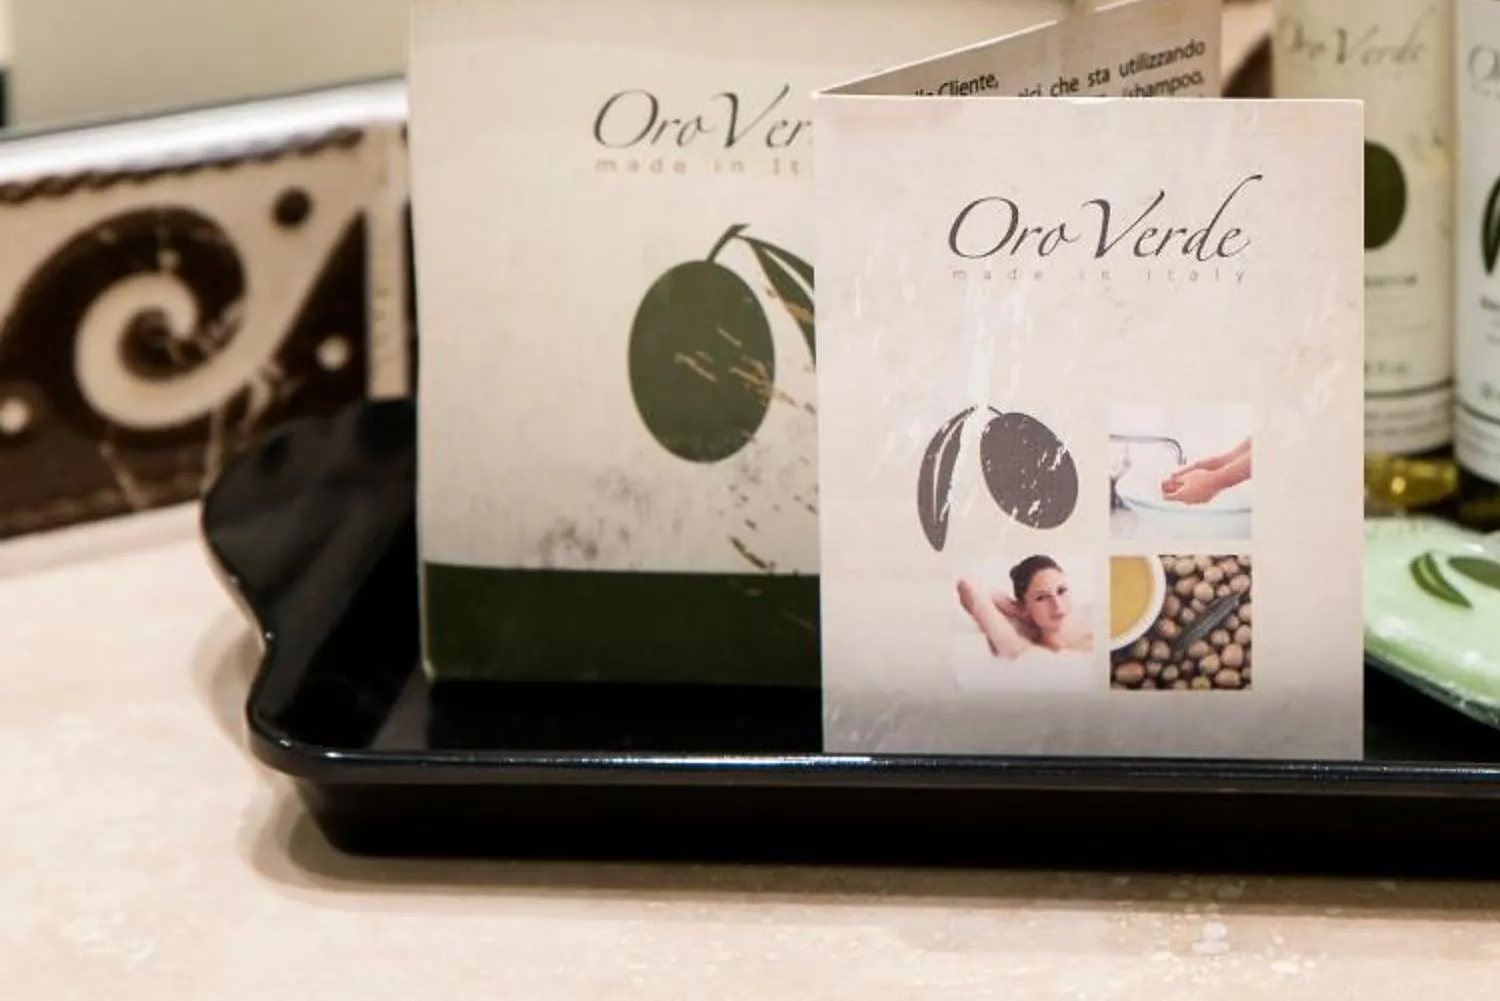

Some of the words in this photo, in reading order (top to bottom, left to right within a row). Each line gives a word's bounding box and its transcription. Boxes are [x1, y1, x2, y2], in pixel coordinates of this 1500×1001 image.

[1050, 76, 1079, 97] che
[1088, 67, 1110, 88] sta
[1119, 39, 1206, 79] utilizzando
[710, 83, 812, 148] Ver
